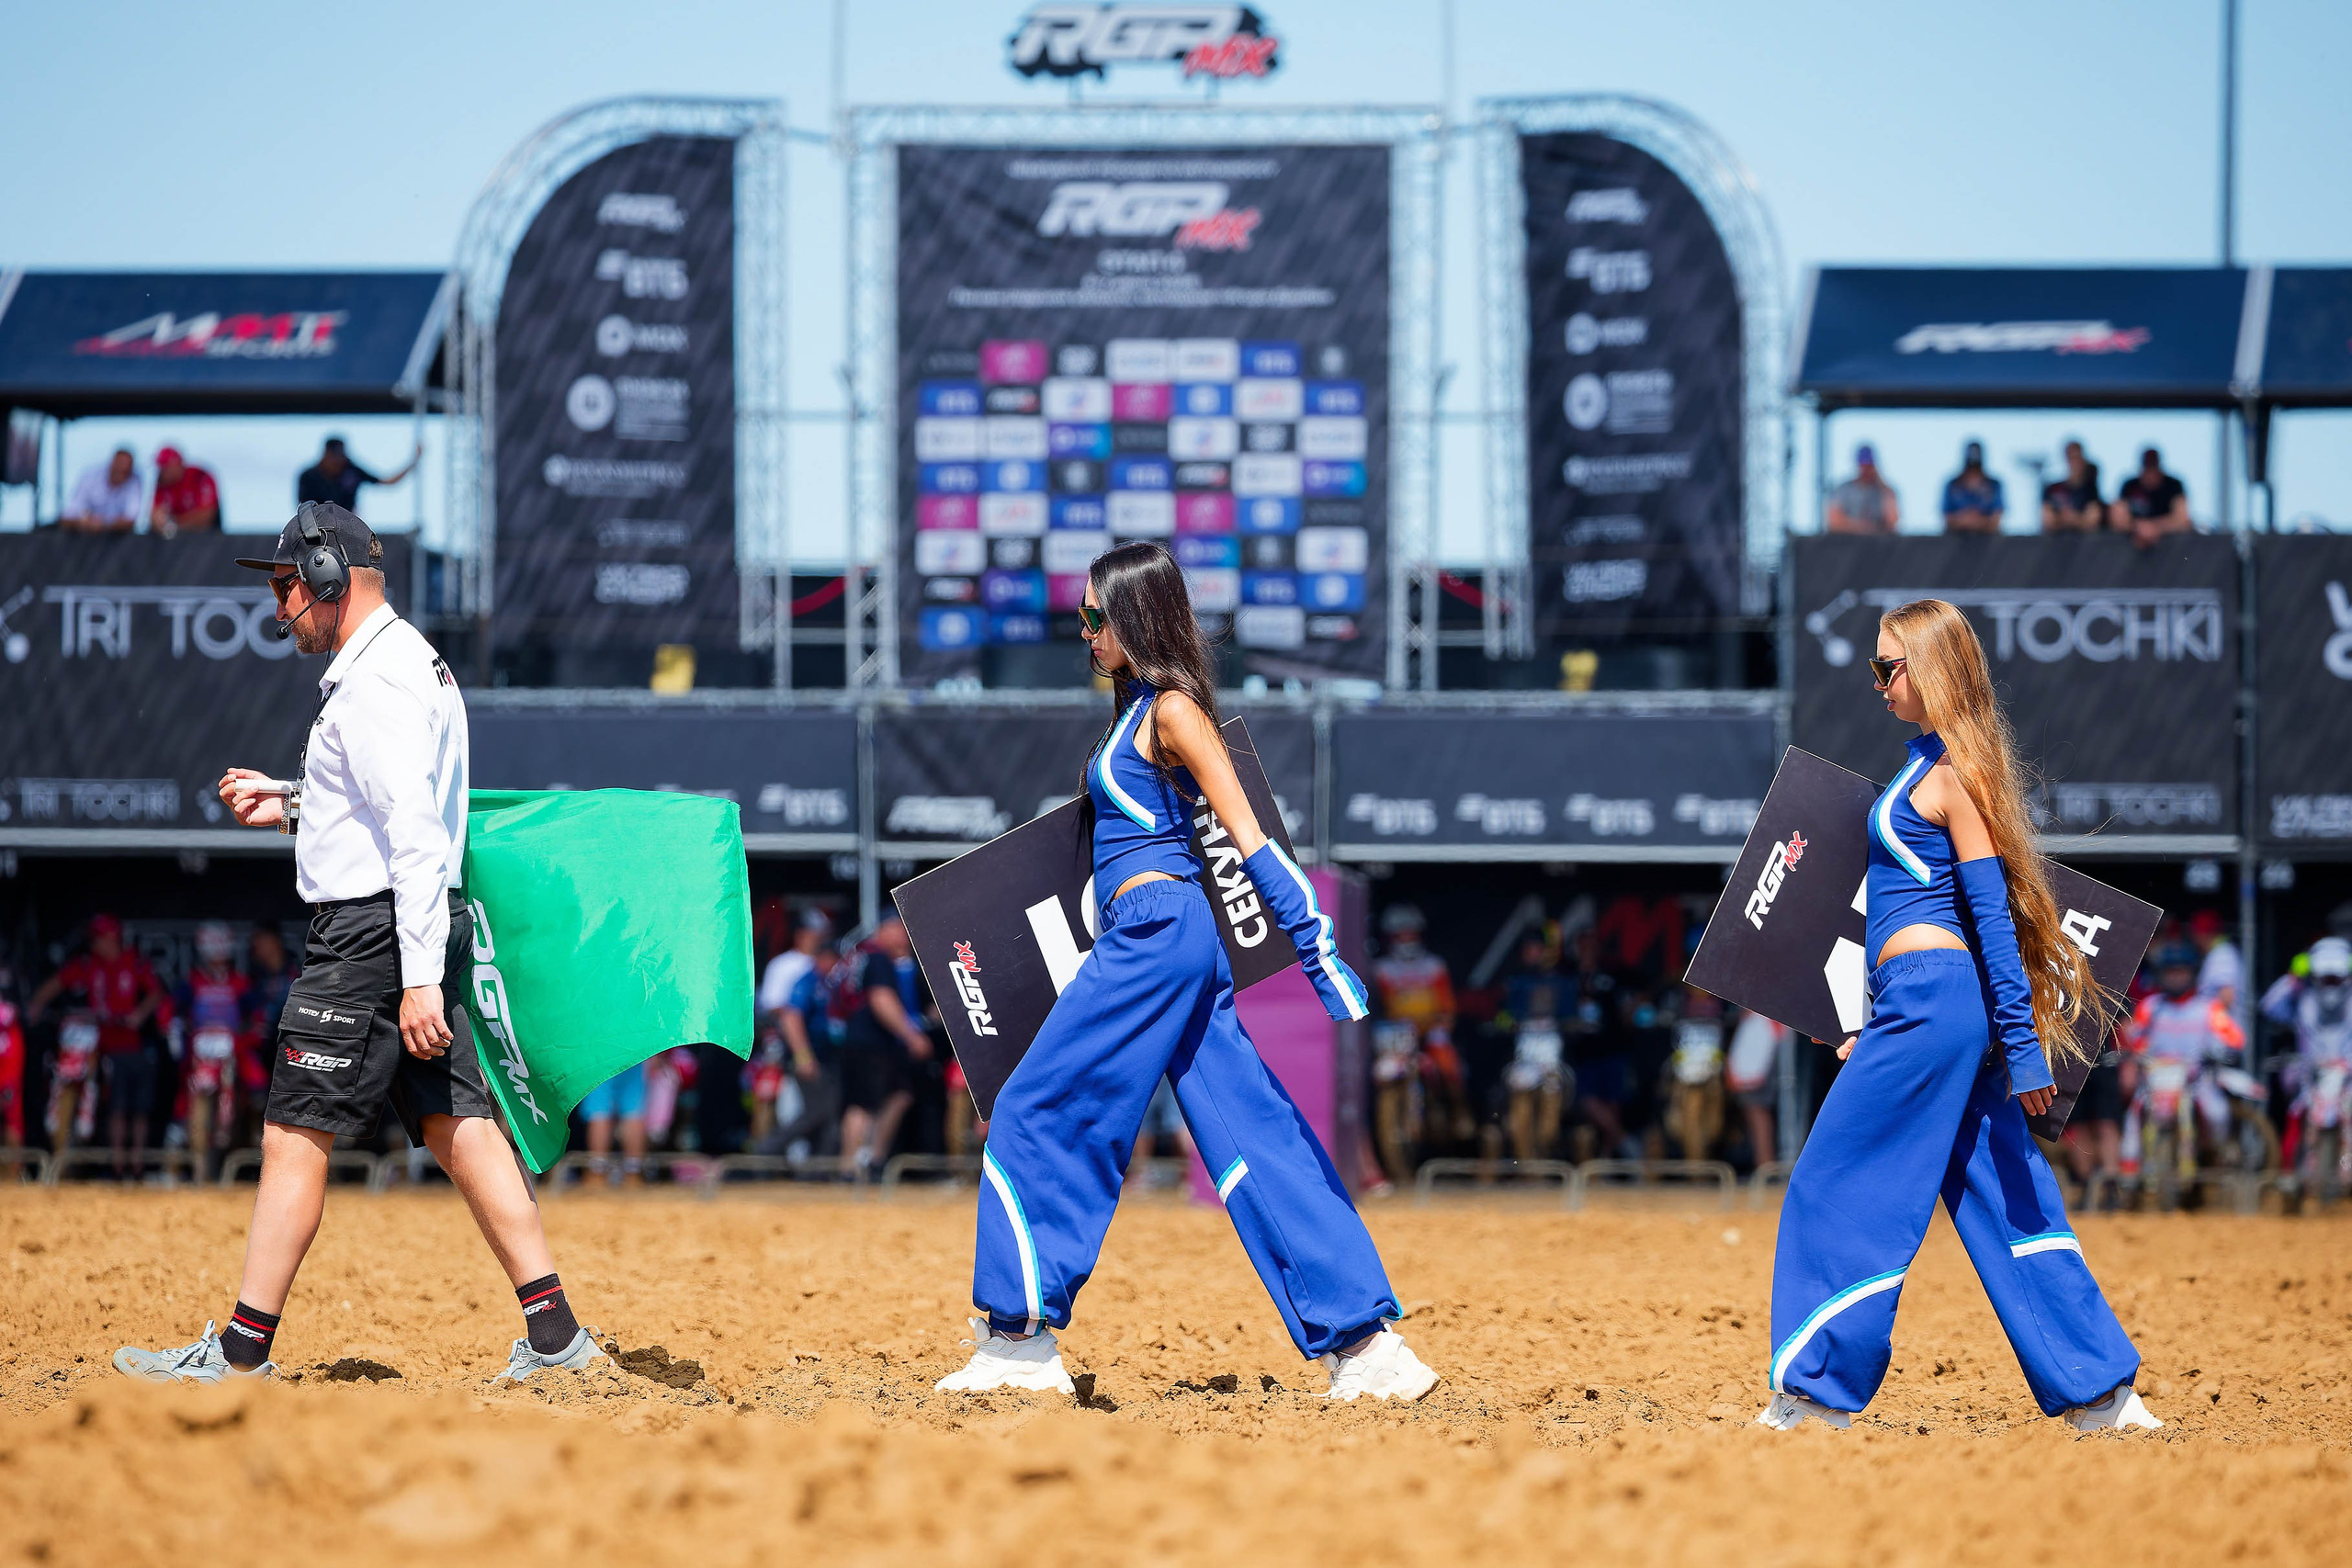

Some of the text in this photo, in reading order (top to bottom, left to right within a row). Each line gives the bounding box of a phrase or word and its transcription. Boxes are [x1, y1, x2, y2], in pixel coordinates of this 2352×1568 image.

[1011, 5, 1242, 64] RGP
[1035, 183, 1231, 237] RGP
[43, 585, 298, 660] TRI TOC
[1982, 597, 2223, 662] TOCHKI
[1745, 830, 1808, 931] RGP MX
[948, 940, 999, 1037] RGP MX
[333, 1015, 356, 1025] SPORT
[300, 1051, 353, 1069] RGP
[499, 1058, 548, 1126] MX
[229, 1320, 266, 1339] RGP
[541, 1301, 557, 1313] MX
